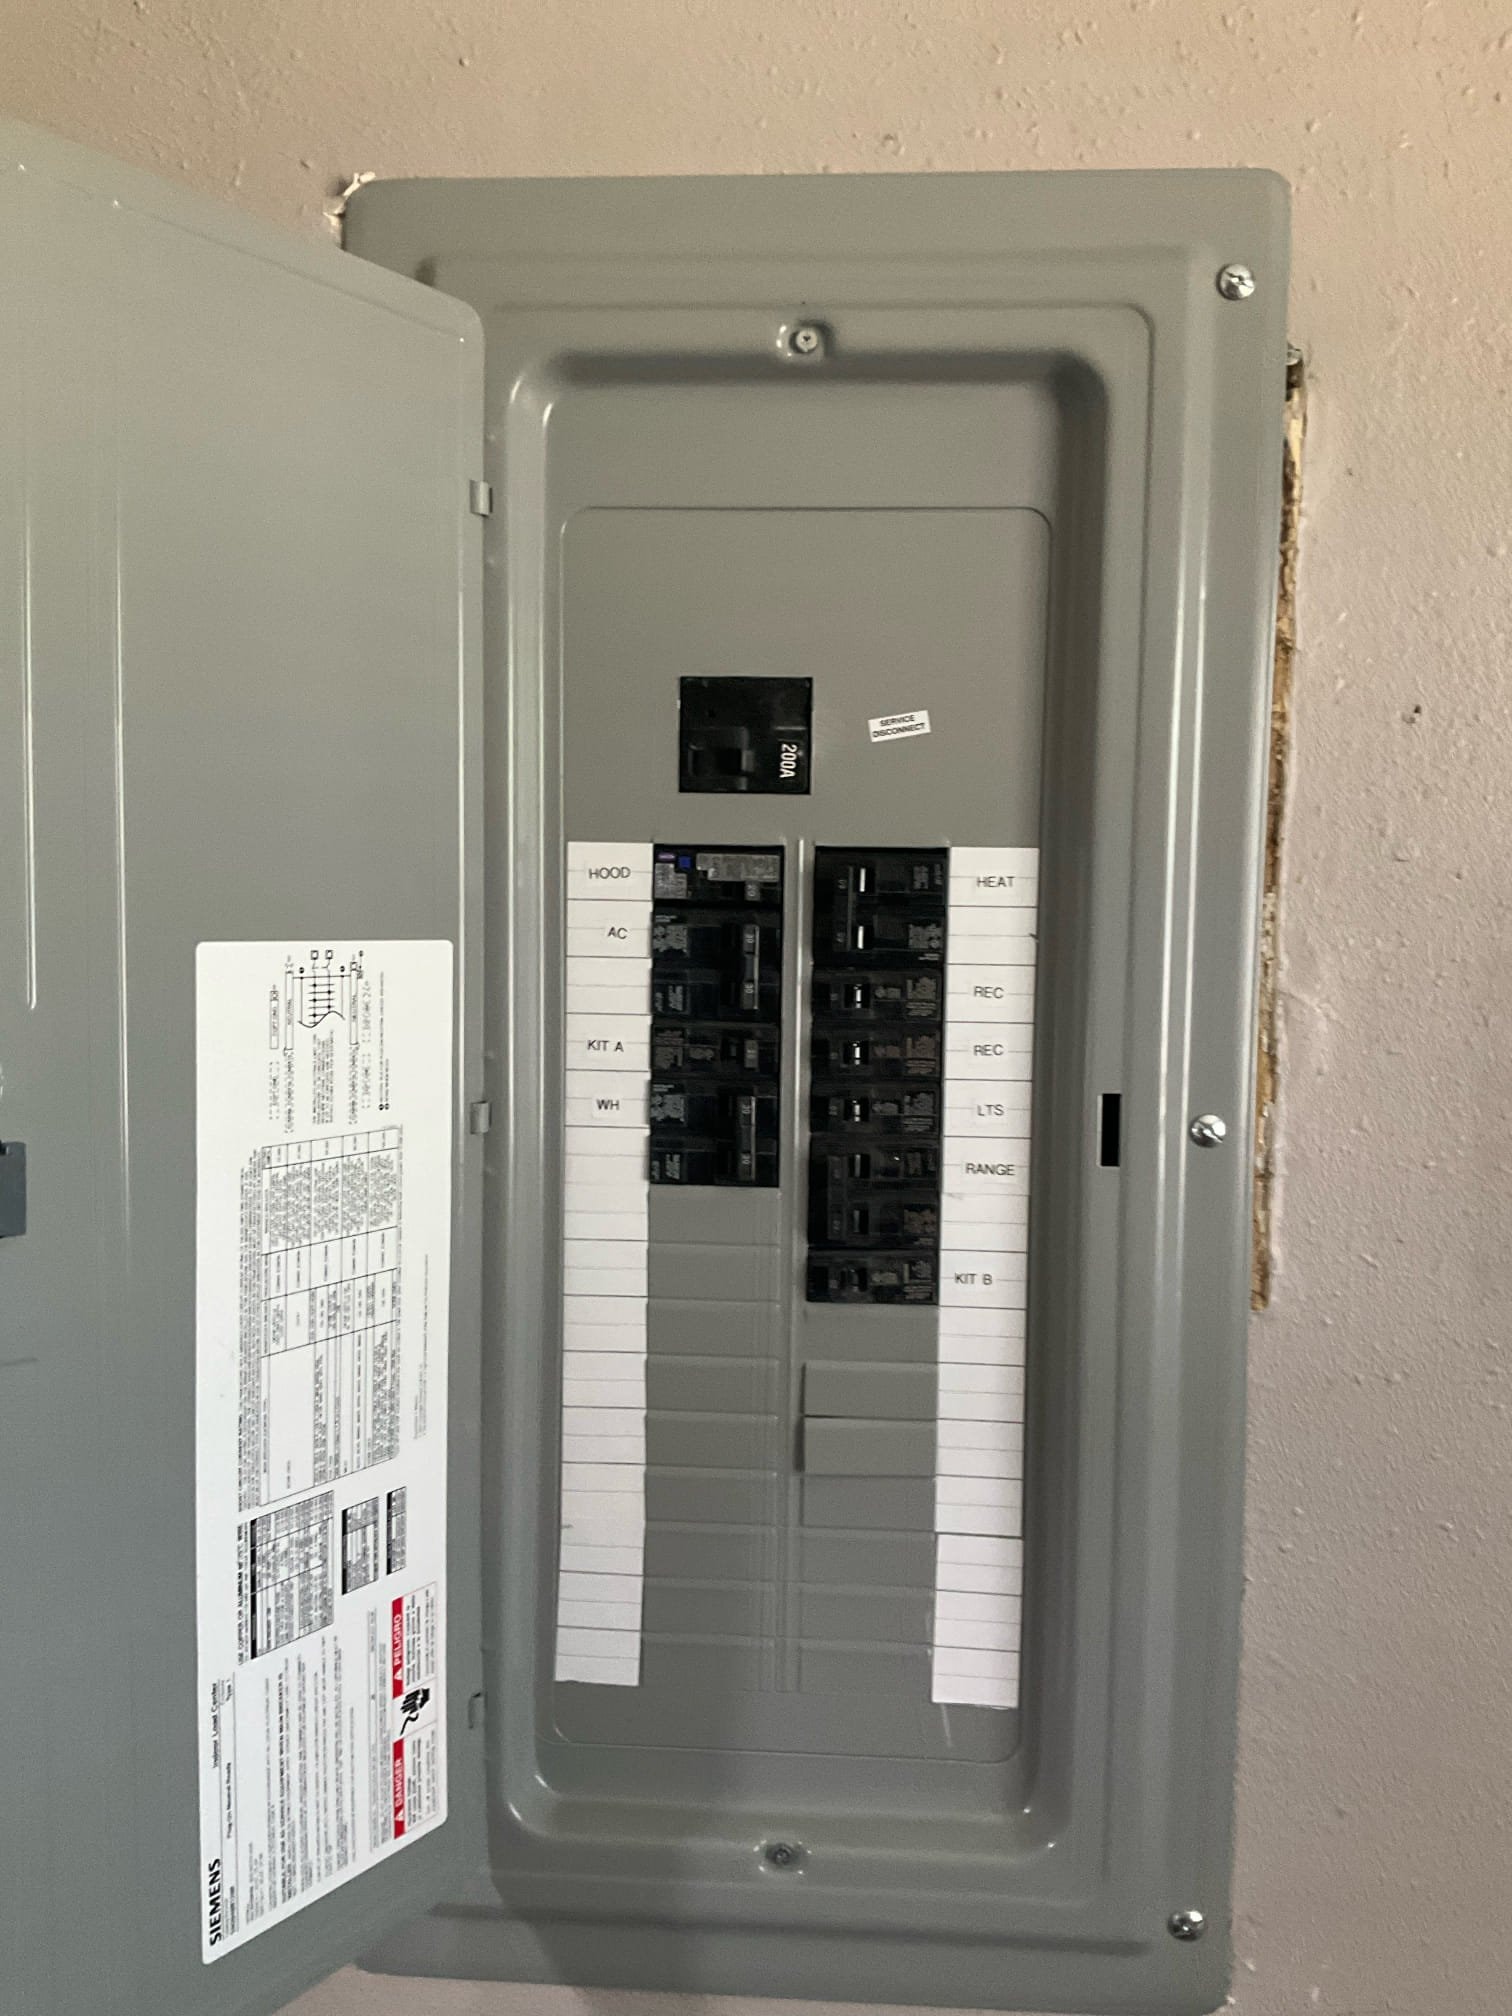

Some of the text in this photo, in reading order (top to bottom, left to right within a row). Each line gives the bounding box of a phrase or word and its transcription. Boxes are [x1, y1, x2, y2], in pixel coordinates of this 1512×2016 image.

[880, 715, 915, 726] SERVICE
[872, 723, 925, 737] DISCONNECT
[780, 744, 797, 777] 200A
[589, 867, 631, 879] HOOD
[976, 876, 1016, 888] HEAT
[607, 926, 628, 939] AC
[974, 986, 1004, 999] REC
[587, 1040, 624, 1052] KIT A
[973, 1044, 1004, 1056] REC
[596, 1100, 620, 1111] WH
[977, 1104, 1004, 1117] LTS
[965, 1163, 1016, 1176] RANGE
[955, 1272, 993, 1285] KIT B
[394, 1614, 402, 1666] PELIGRO
[395, 1758, 403, 1806] DANGER
[208, 1859, 221, 1946] SIEMENS
